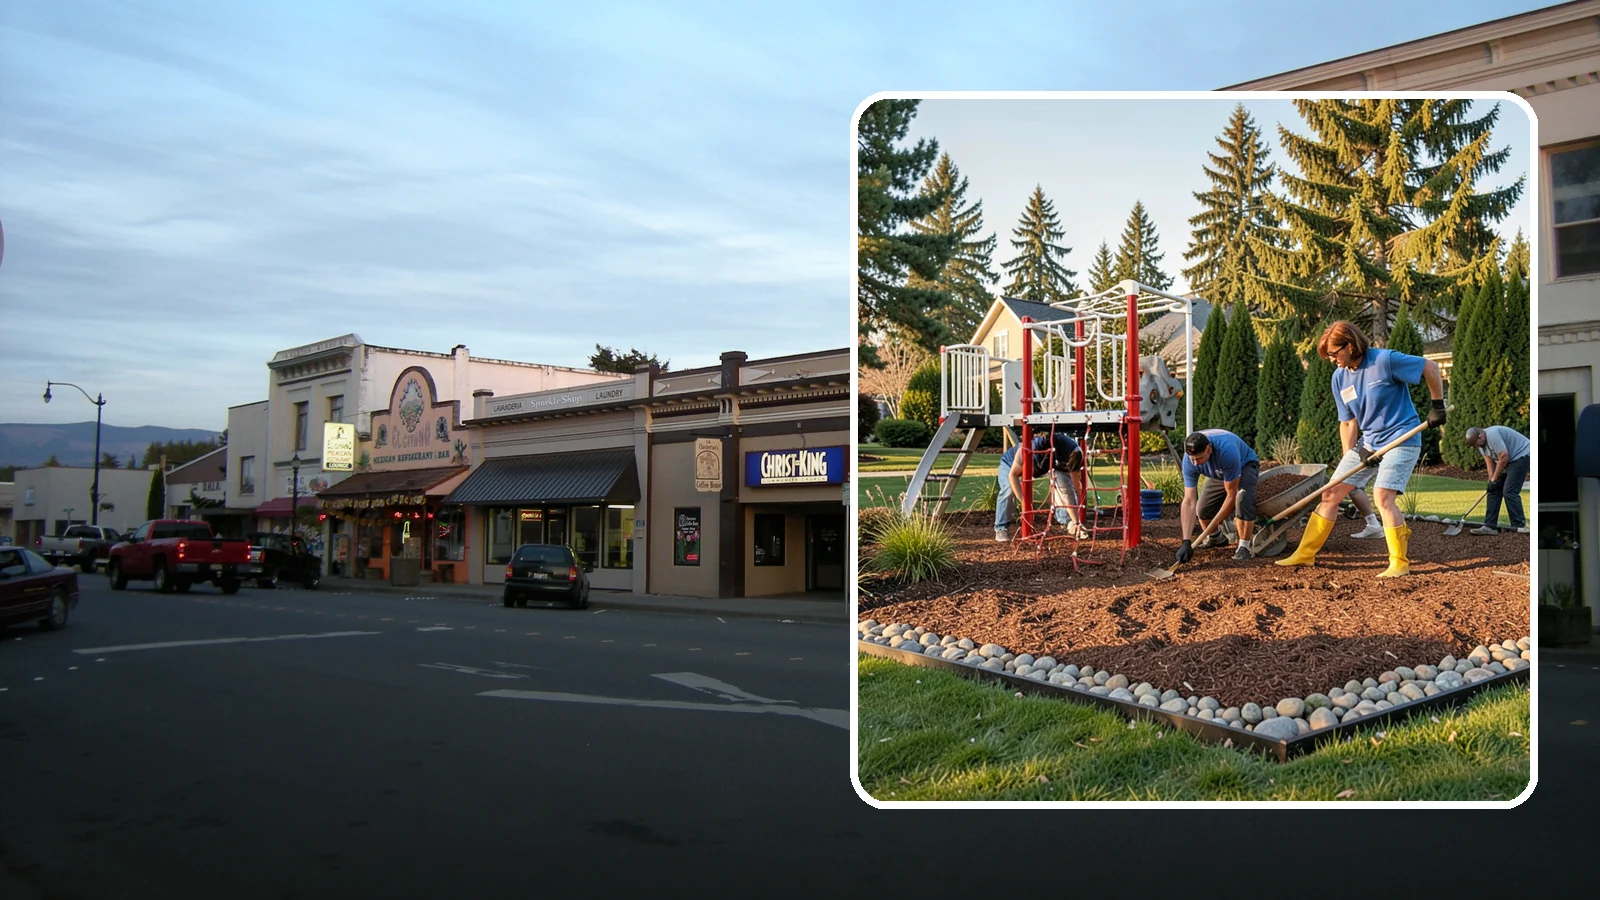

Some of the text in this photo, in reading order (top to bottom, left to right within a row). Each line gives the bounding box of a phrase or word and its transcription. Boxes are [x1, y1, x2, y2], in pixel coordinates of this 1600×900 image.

[562, 394, 582, 405] Shop
[596, 388, 624, 400] LAUNDRY
[494, 402, 522, 412] LAVANDERIA
[374, 455, 396, 464] MEXICAN
[398, 452, 433, 462] RESTAURANT
[438, 450, 450, 458] BAR
[760, 450, 827, 478] CHRIST KING
